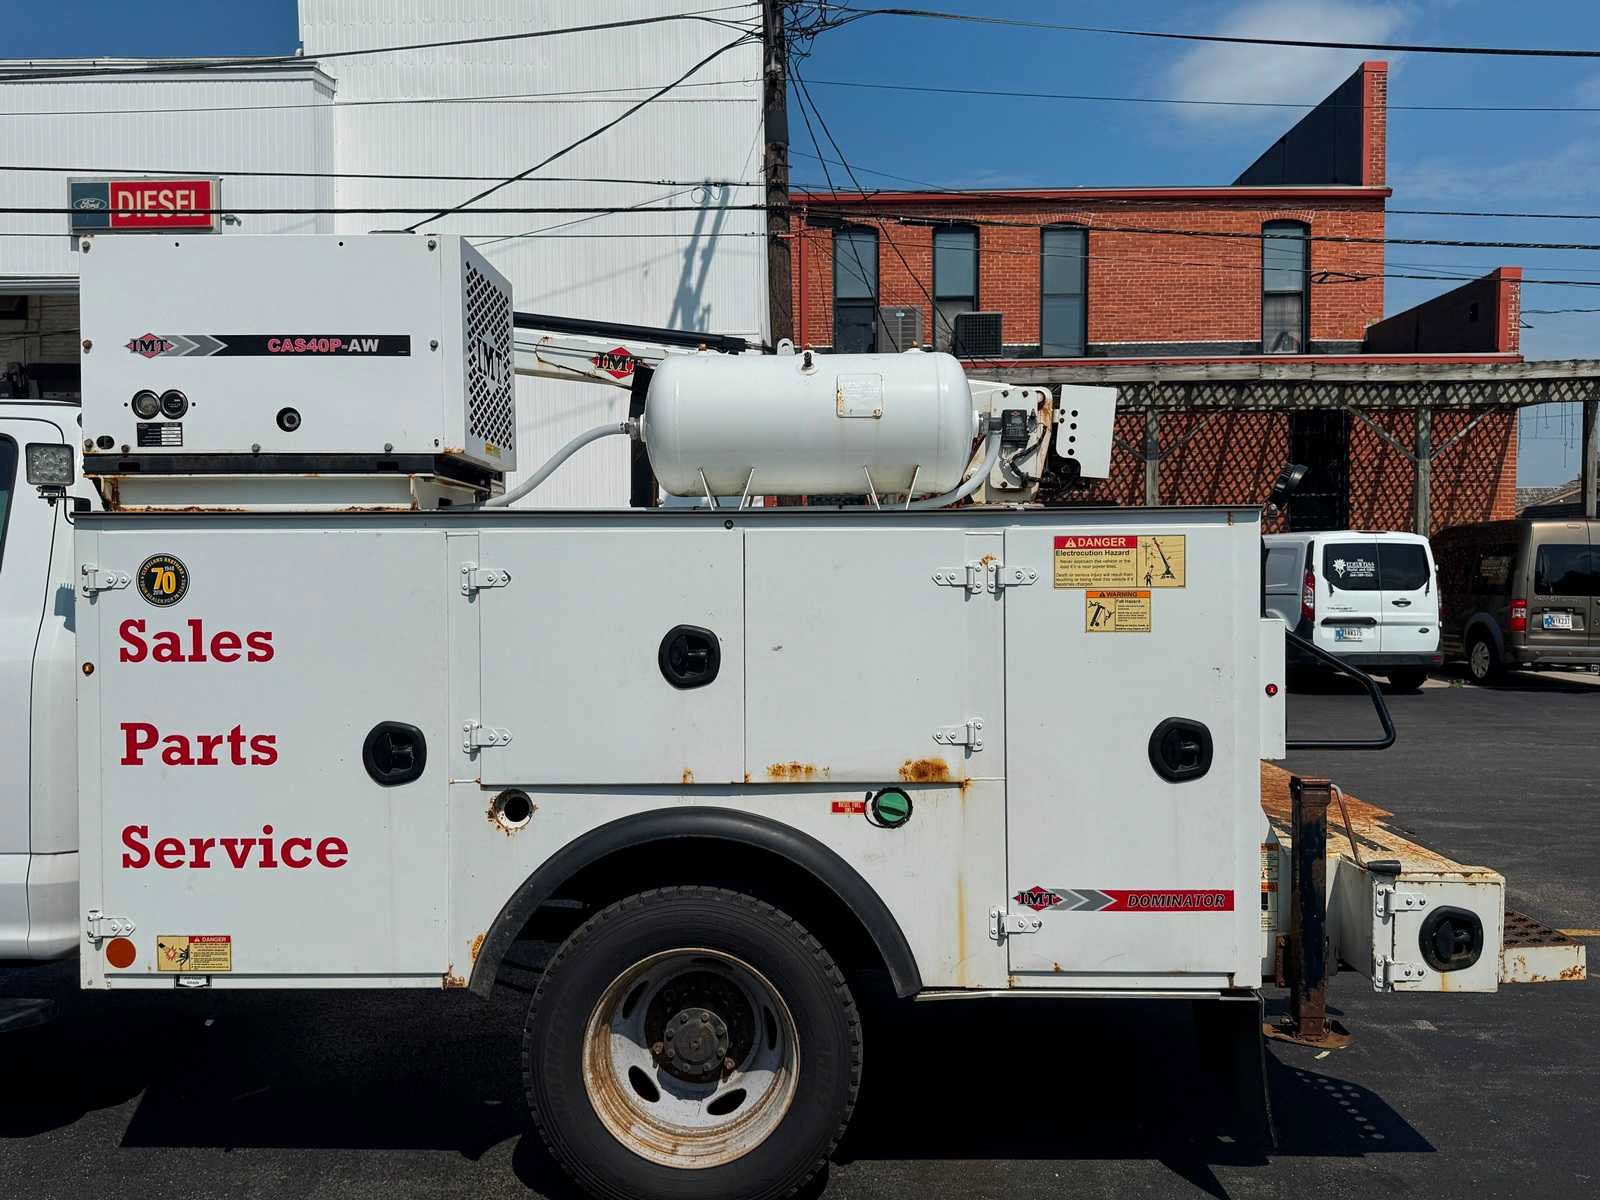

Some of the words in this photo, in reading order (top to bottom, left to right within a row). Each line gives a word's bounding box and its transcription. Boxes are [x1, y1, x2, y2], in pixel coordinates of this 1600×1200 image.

[118, 189, 204, 218] DIESEL
[129, 339, 168, 352] IMT
[267, 338, 380, 353] CAS40P-AW
[476, 336, 503, 386] IMT
[1078, 538, 1126, 547] DANGER
[151, 567, 176, 594] 70
[119, 618, 275, 663] Sales
[120, 722, 278, 766] Parts
[121, 824, 349, 869] Service
[1018, 891, 1057, 906] IMT
[1127, 894, 1225, 907] DOMINATOR
